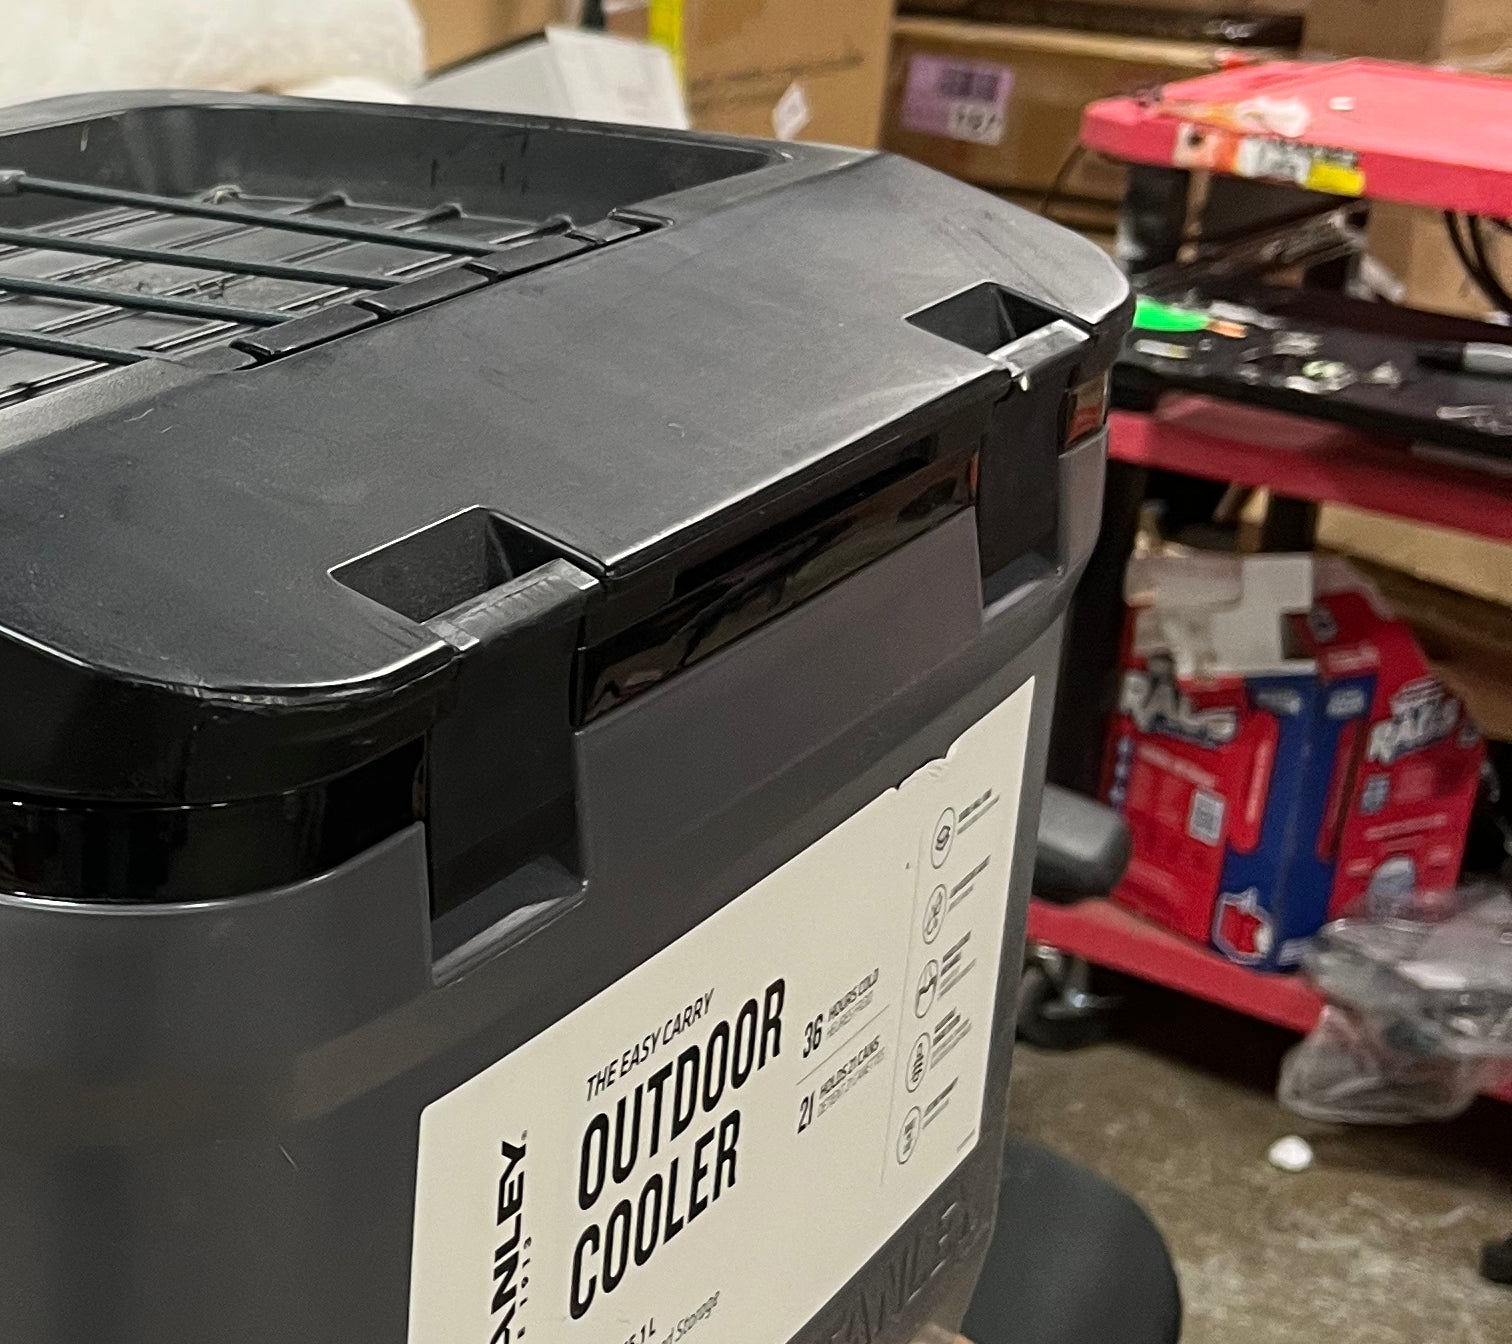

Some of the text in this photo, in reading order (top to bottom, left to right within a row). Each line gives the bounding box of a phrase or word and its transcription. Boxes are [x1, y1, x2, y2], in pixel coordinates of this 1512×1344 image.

[577, 976, 786, 1212] OUTDOOR
[586, 987, 716, 1103] THE EASY CARRY
[802, 1012, 824, 1060] 36
[796, 1089, 816, 1135] 21
[568, 1108, 742, 1321] COOLER
